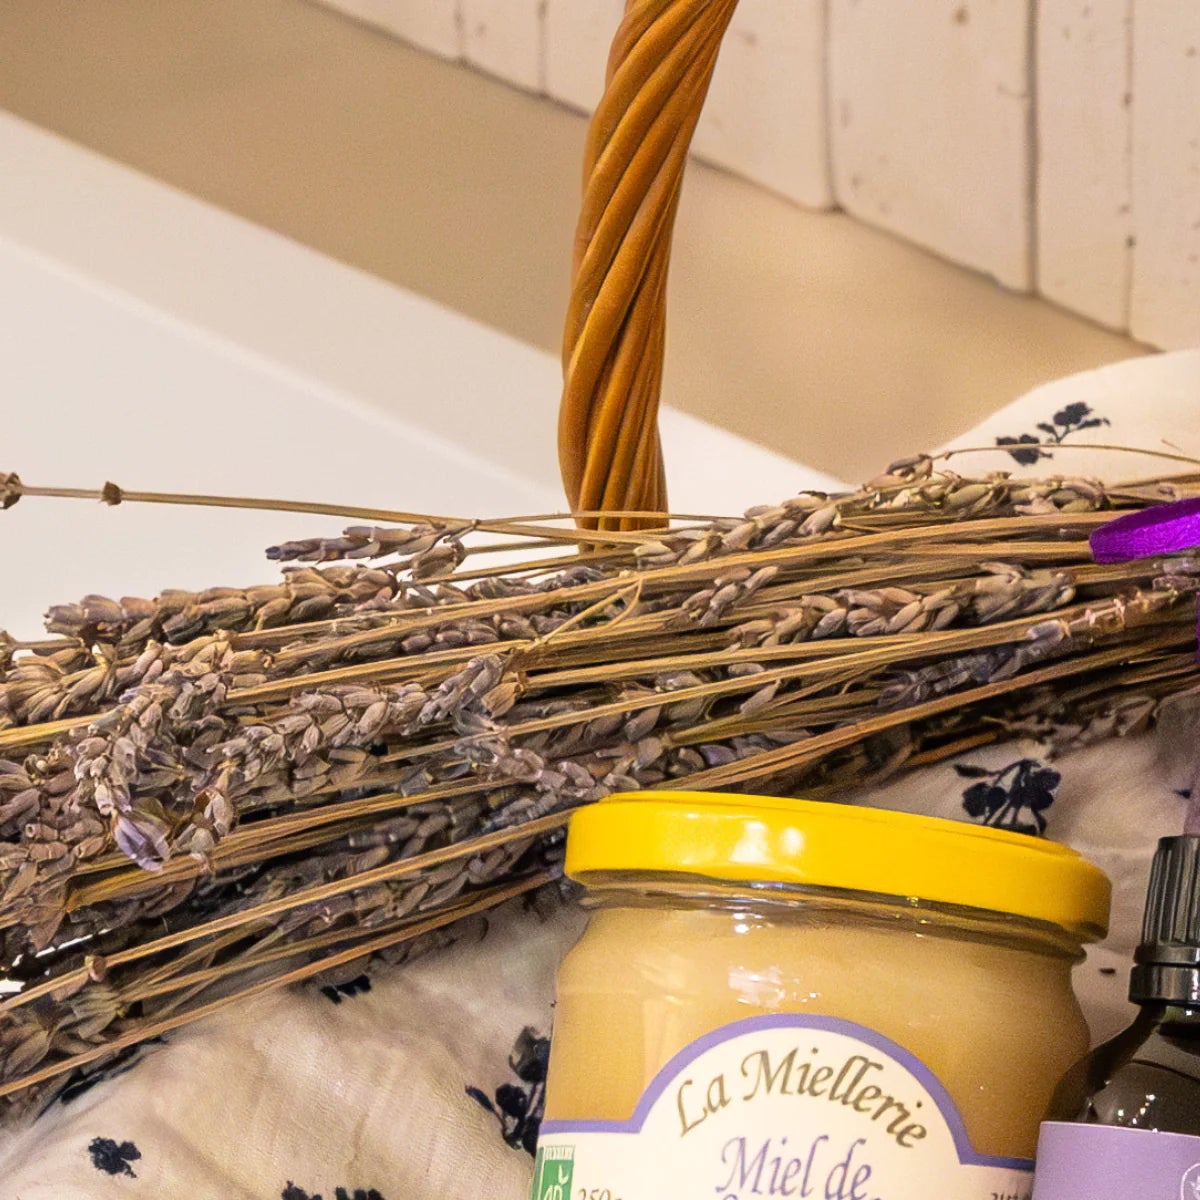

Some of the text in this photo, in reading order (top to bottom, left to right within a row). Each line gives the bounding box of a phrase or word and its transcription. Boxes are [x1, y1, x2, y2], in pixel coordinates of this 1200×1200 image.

[677, 1047, 927, 1148] La Miellerie
[715, 1134, 829, 1198] Miel
